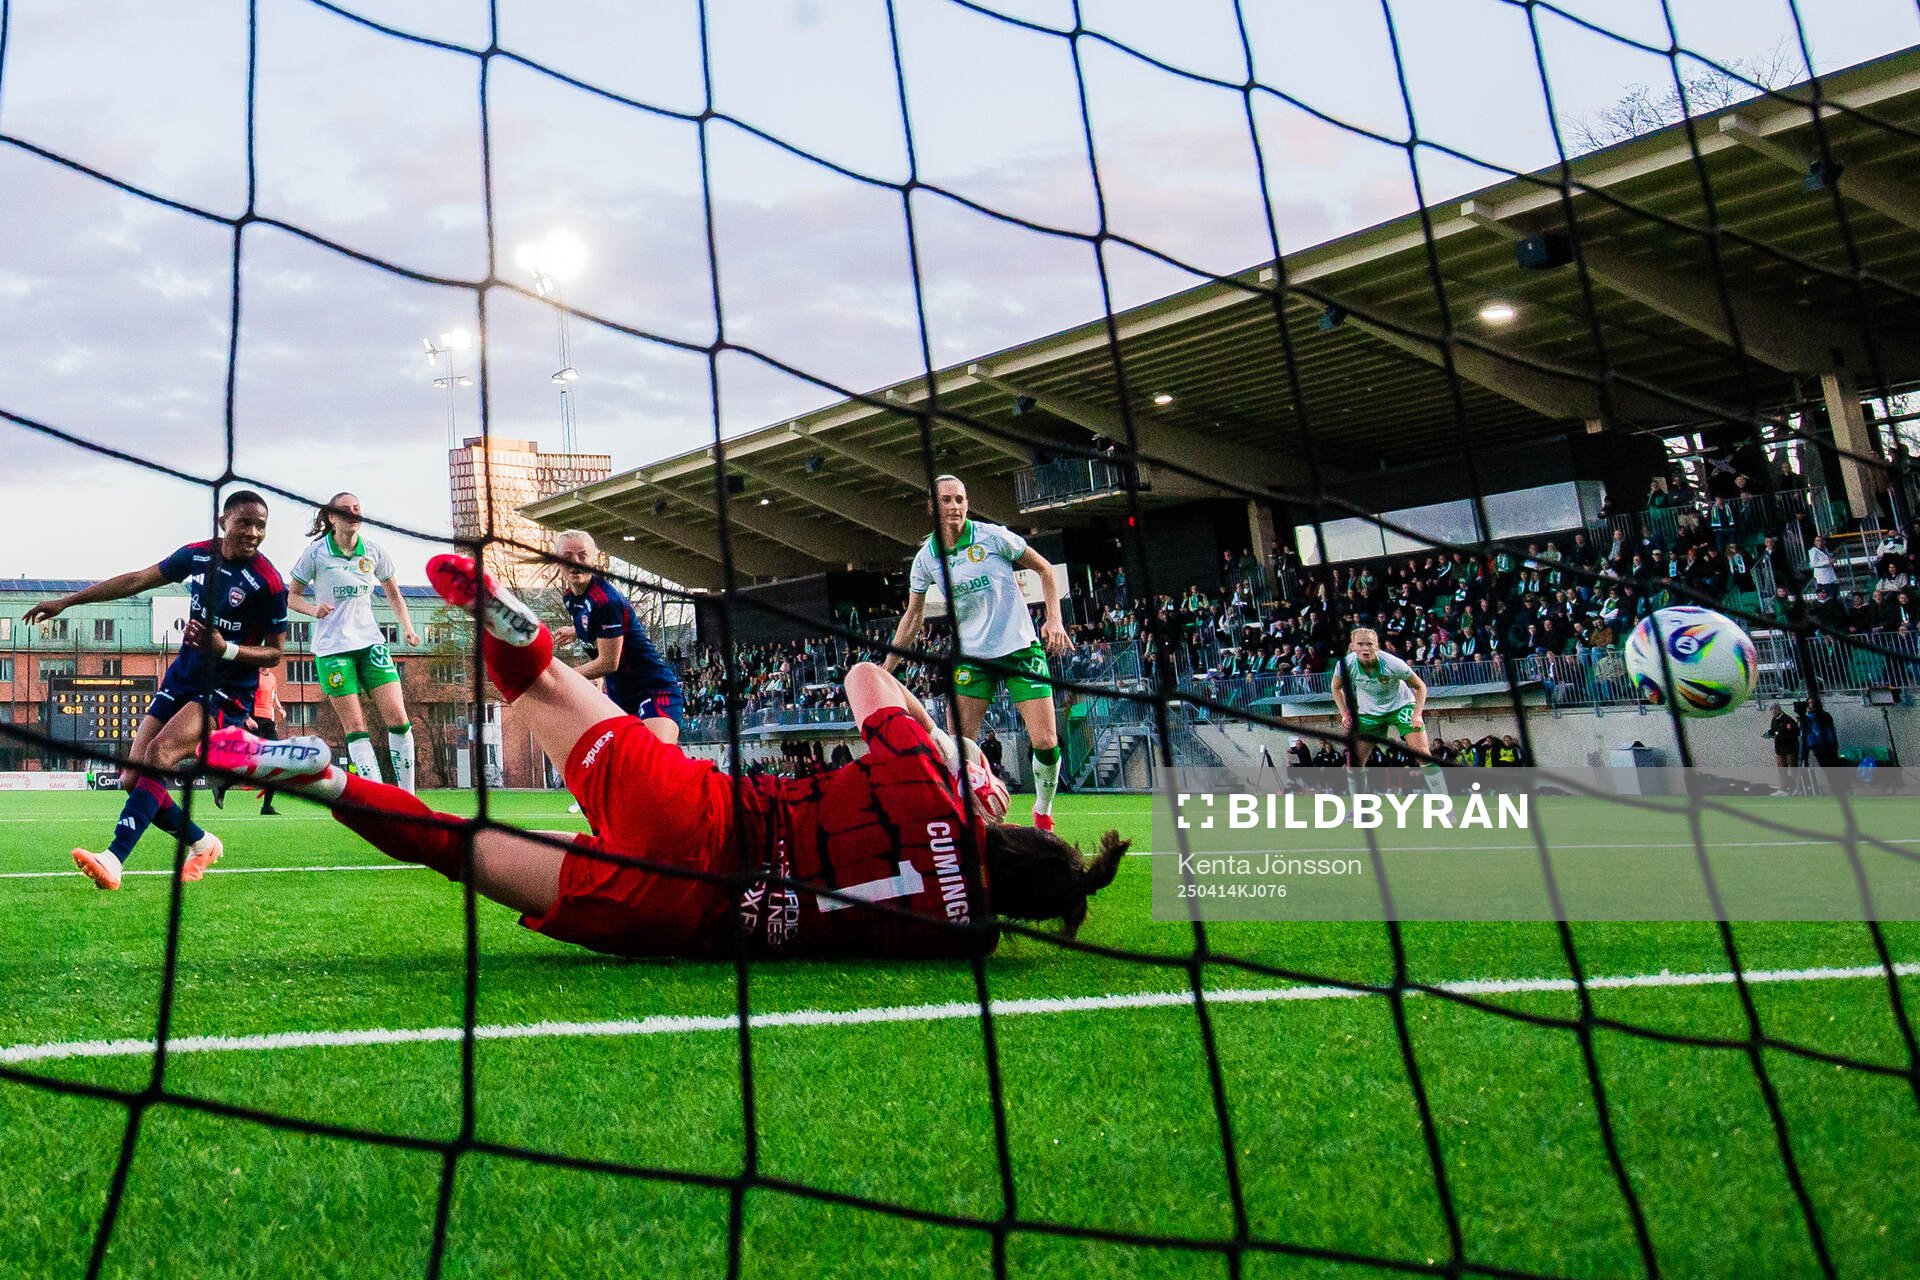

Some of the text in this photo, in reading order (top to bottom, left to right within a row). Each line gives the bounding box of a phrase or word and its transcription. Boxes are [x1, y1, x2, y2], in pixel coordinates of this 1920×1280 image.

[582, 731, 614, 768] scandic
[816, 860, 925, 913] 1
[926, 821, 971, 926] CUMINGS
